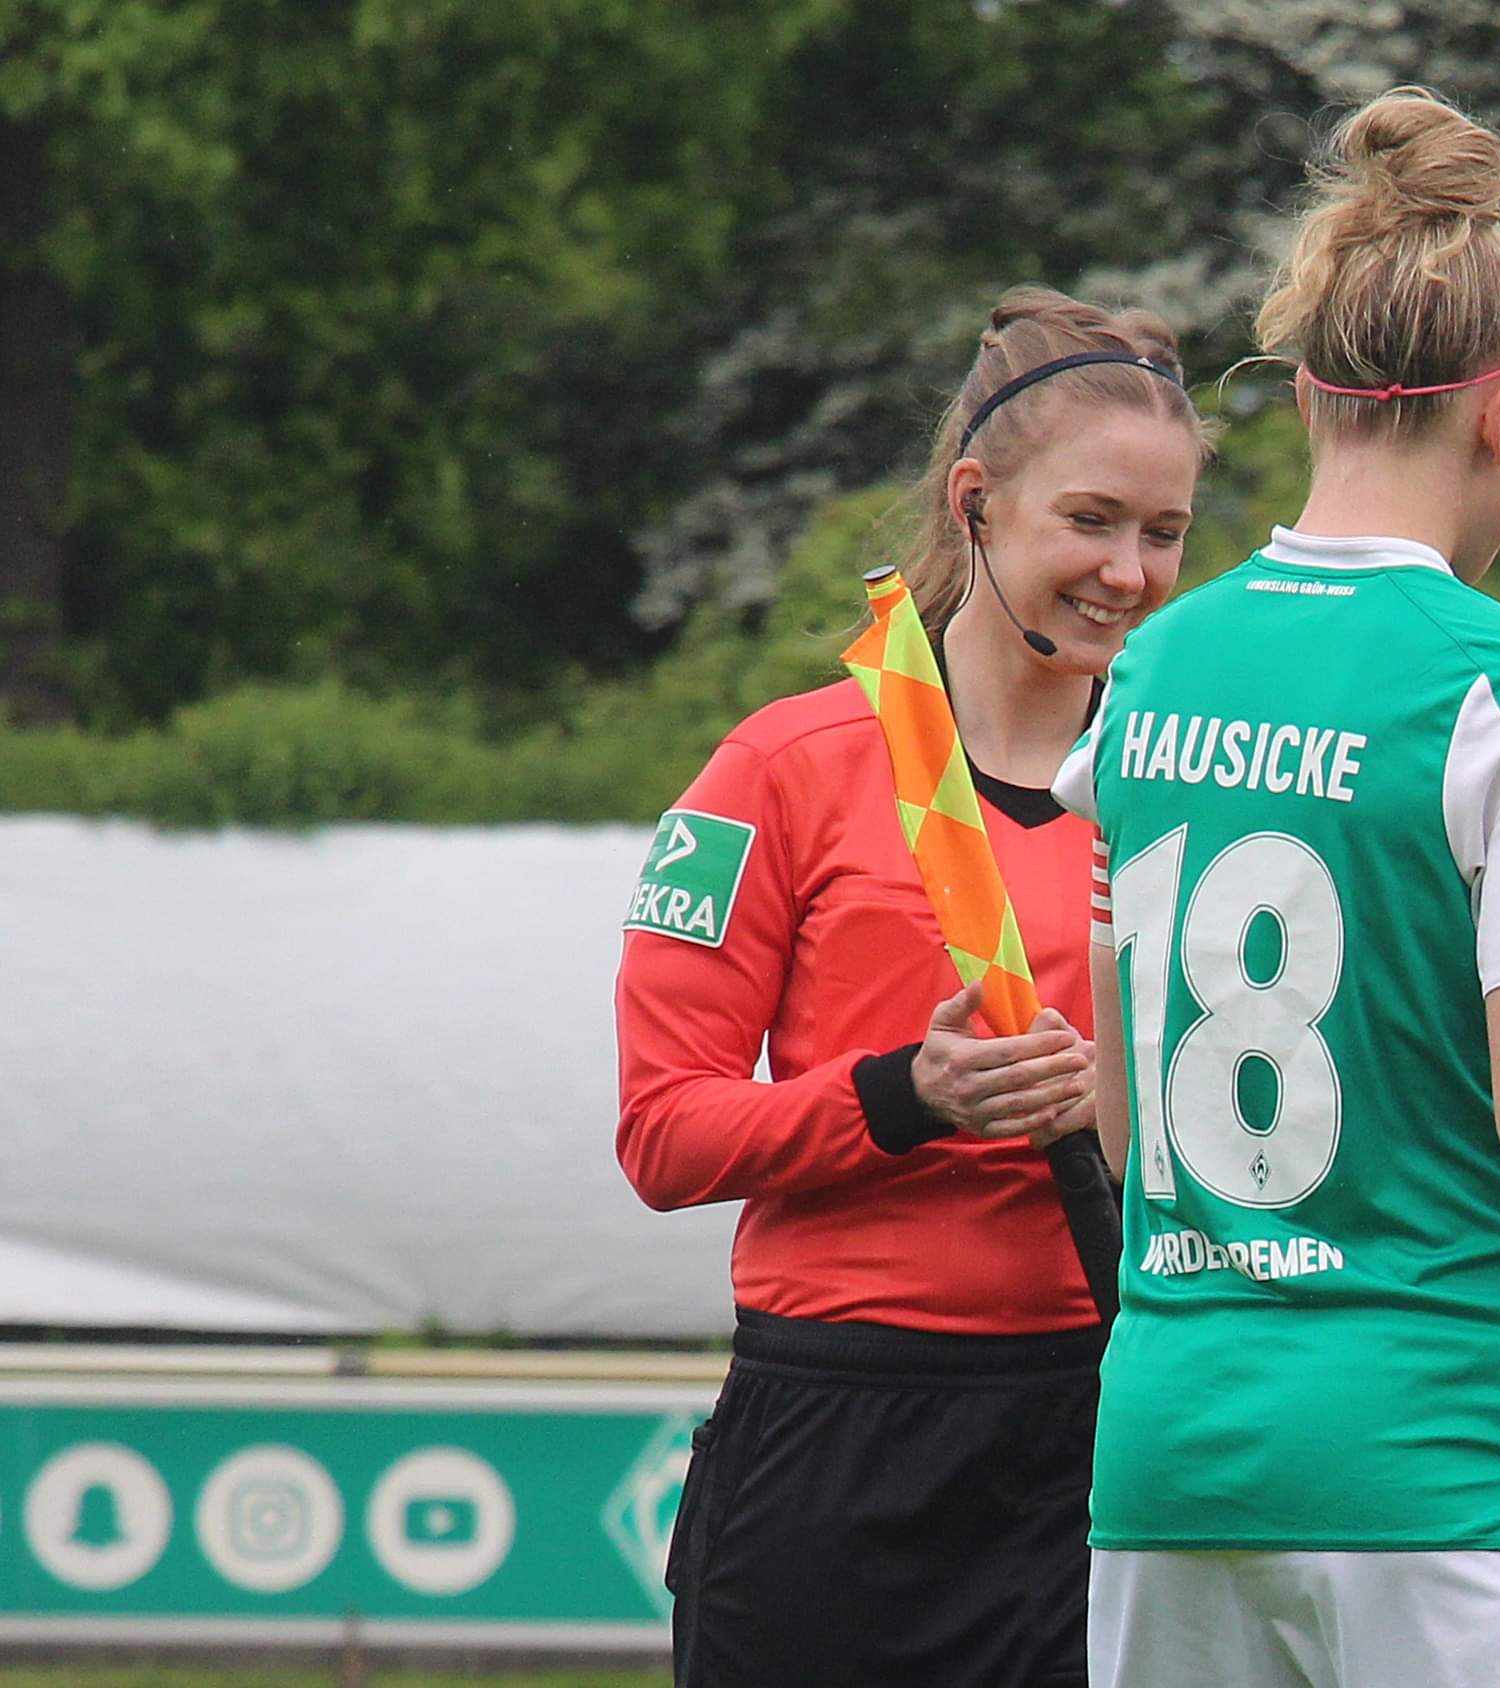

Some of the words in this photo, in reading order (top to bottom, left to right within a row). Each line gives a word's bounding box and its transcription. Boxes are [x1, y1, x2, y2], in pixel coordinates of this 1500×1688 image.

[1120, 711, 1367, 802] HAUSICKE
[1113, 822, 1344, 1210] 18
[1227, 1237, 1344, 1281] REMEN
